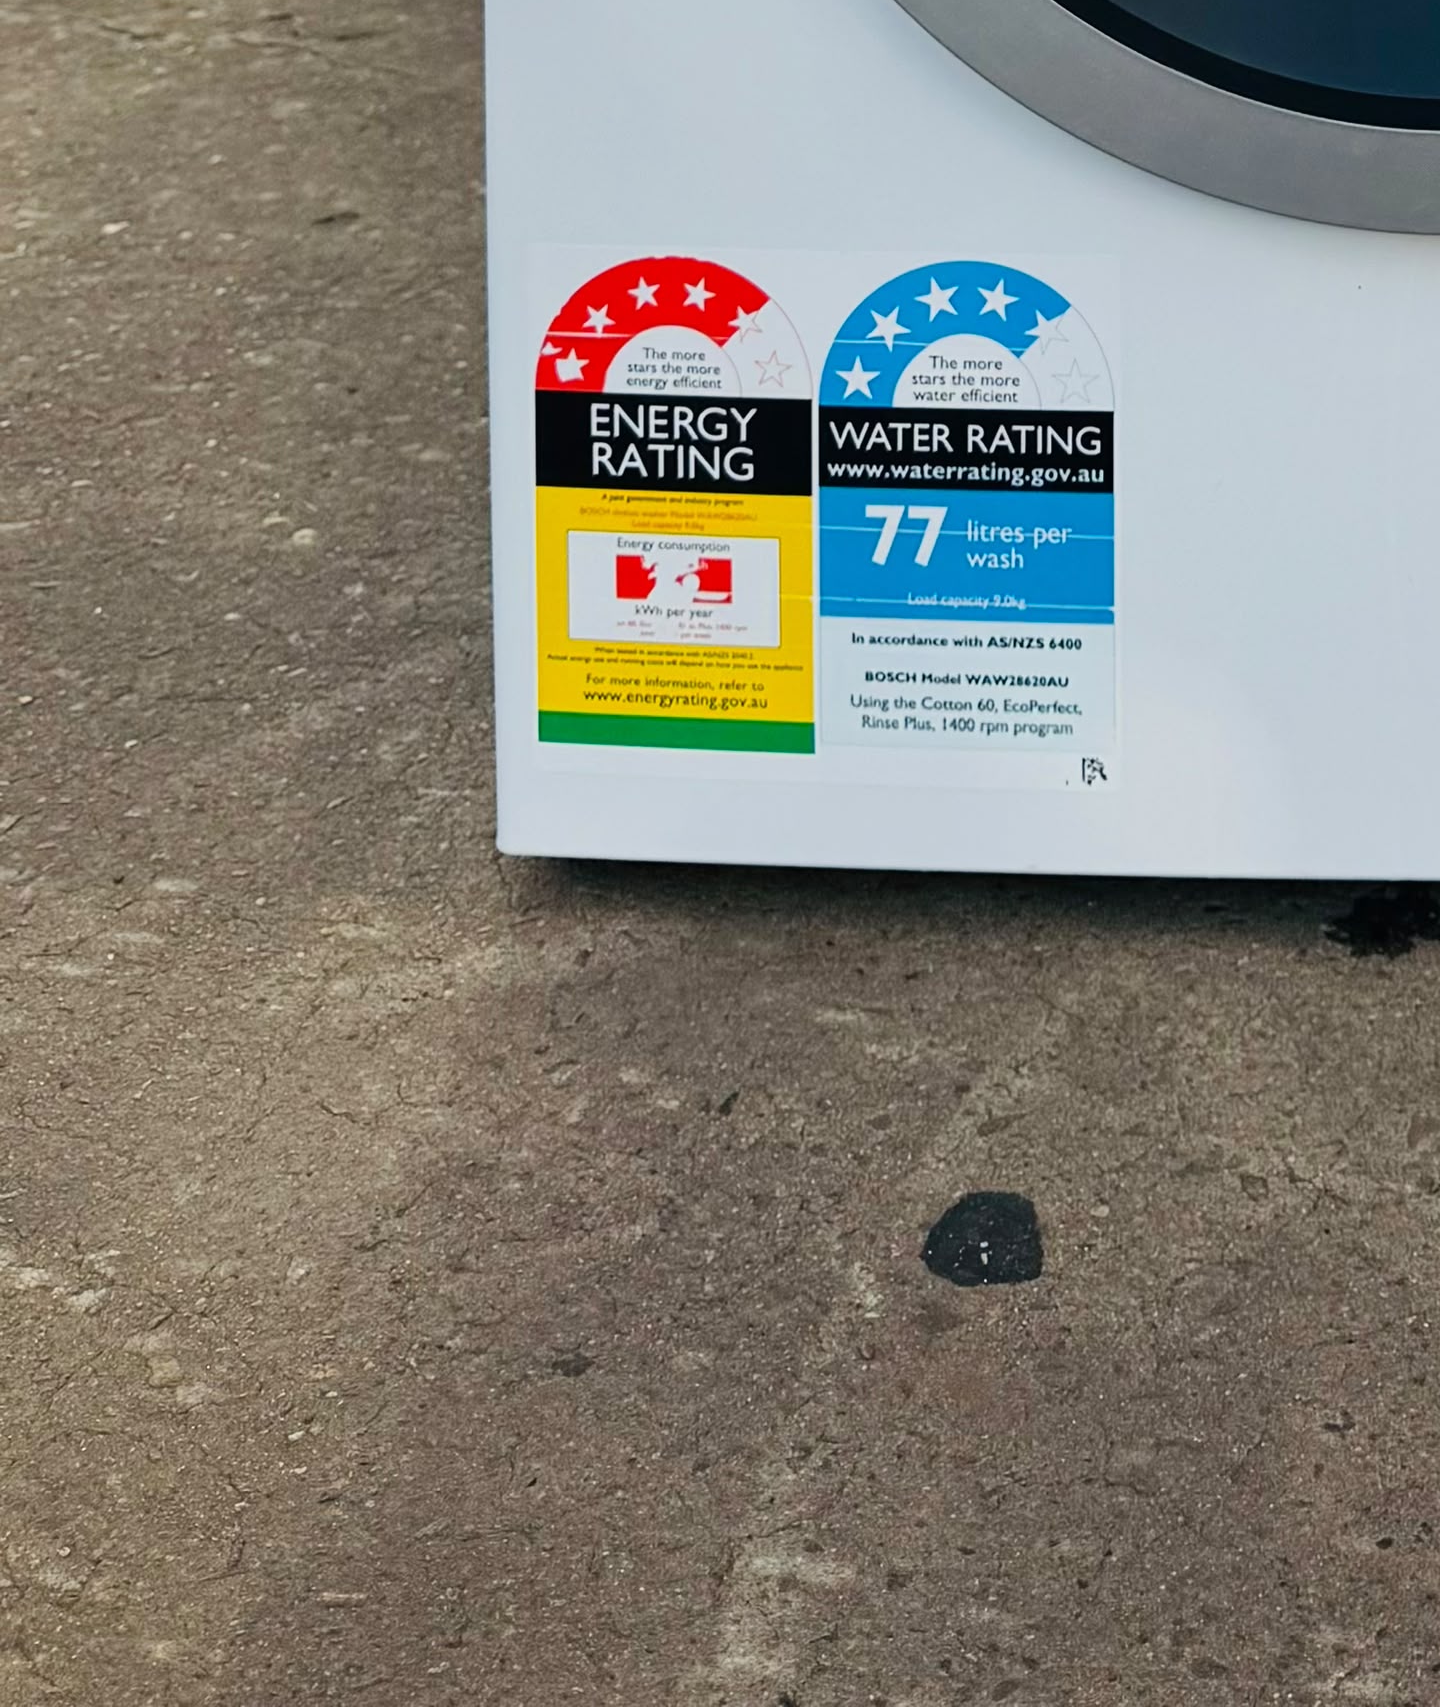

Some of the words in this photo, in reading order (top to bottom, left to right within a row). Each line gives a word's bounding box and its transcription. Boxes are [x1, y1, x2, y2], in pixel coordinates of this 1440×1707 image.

[642, 348, 667, 360] The
[672, 350, 705, 361] more
[929, 355, 958, 369] The
[963, 359, 1002, 370] more
[627, 362, 657, 373] stars
[662, 363, 683, 375] the
[687, 365, 720, 375] more
[627, 378, 667, 389] energy
[673, 377, 722, 389] efficient
[912, 374, 946, 385] stars
[952, 373, 976, 386] the
[980, 375, 1020, 387] more
[913, 390, 956, 401] water
[962, 390, 1018, 403] efficient
[590, 402, 757, 442] ENERGY
[829, 421, 954, 453] WATER
[968, 424, 1101, 455] RATING
[592, 442, 754, 482] RATING
[828, 461, 1104, 487] www.waterrating.gov.au
[865, 504, 948, 567] 77
[966, 519, 1024, 543] litres
[1033, 527, 1070, 549] per
[617, 537, 655, 552] Energy
[658, 540, 730, 552] consumption
[966, 548, 1024, 569] wash
[908, 592, 936, 605] Load
[666, 607, 685, 617] per
[689, 608, 713, 618] year
[852, 633, 864, 645] In
[868, 634, 948, 647] accordance
[953, 635, 983, 648] with
[987, 637, 1044, 649] AS/NZS
[1049, 639, 1082, 650] 6400
[586, 674, 606, 684] For
[610, 675, 641, 686] more
[645, 675, 715, 690] information,
[719, 679, 747, 691] refer
[752, 681, 764, 691] to
[865, 671, 917, 683] BOSCH
[921, 673, 961, 685] Model
[583, 690, 768, 710] www.energyrating.gov.au
[850, 694, 890, 711] Using
[894, 696, 916, 709] the
[921, 697, 972, 711] Cotton
[977, 699, 998, 713] 60,
[1004, 699, 1082, 715] EcoPerfect,
[862, 715, 900, 729] Rinse
[904, 717, 936, 732] Plus,
[942, 717, 975, 732] 1400
[980, 721, 1009, 735] rpm
[1014, 722, 1074, 737] program
